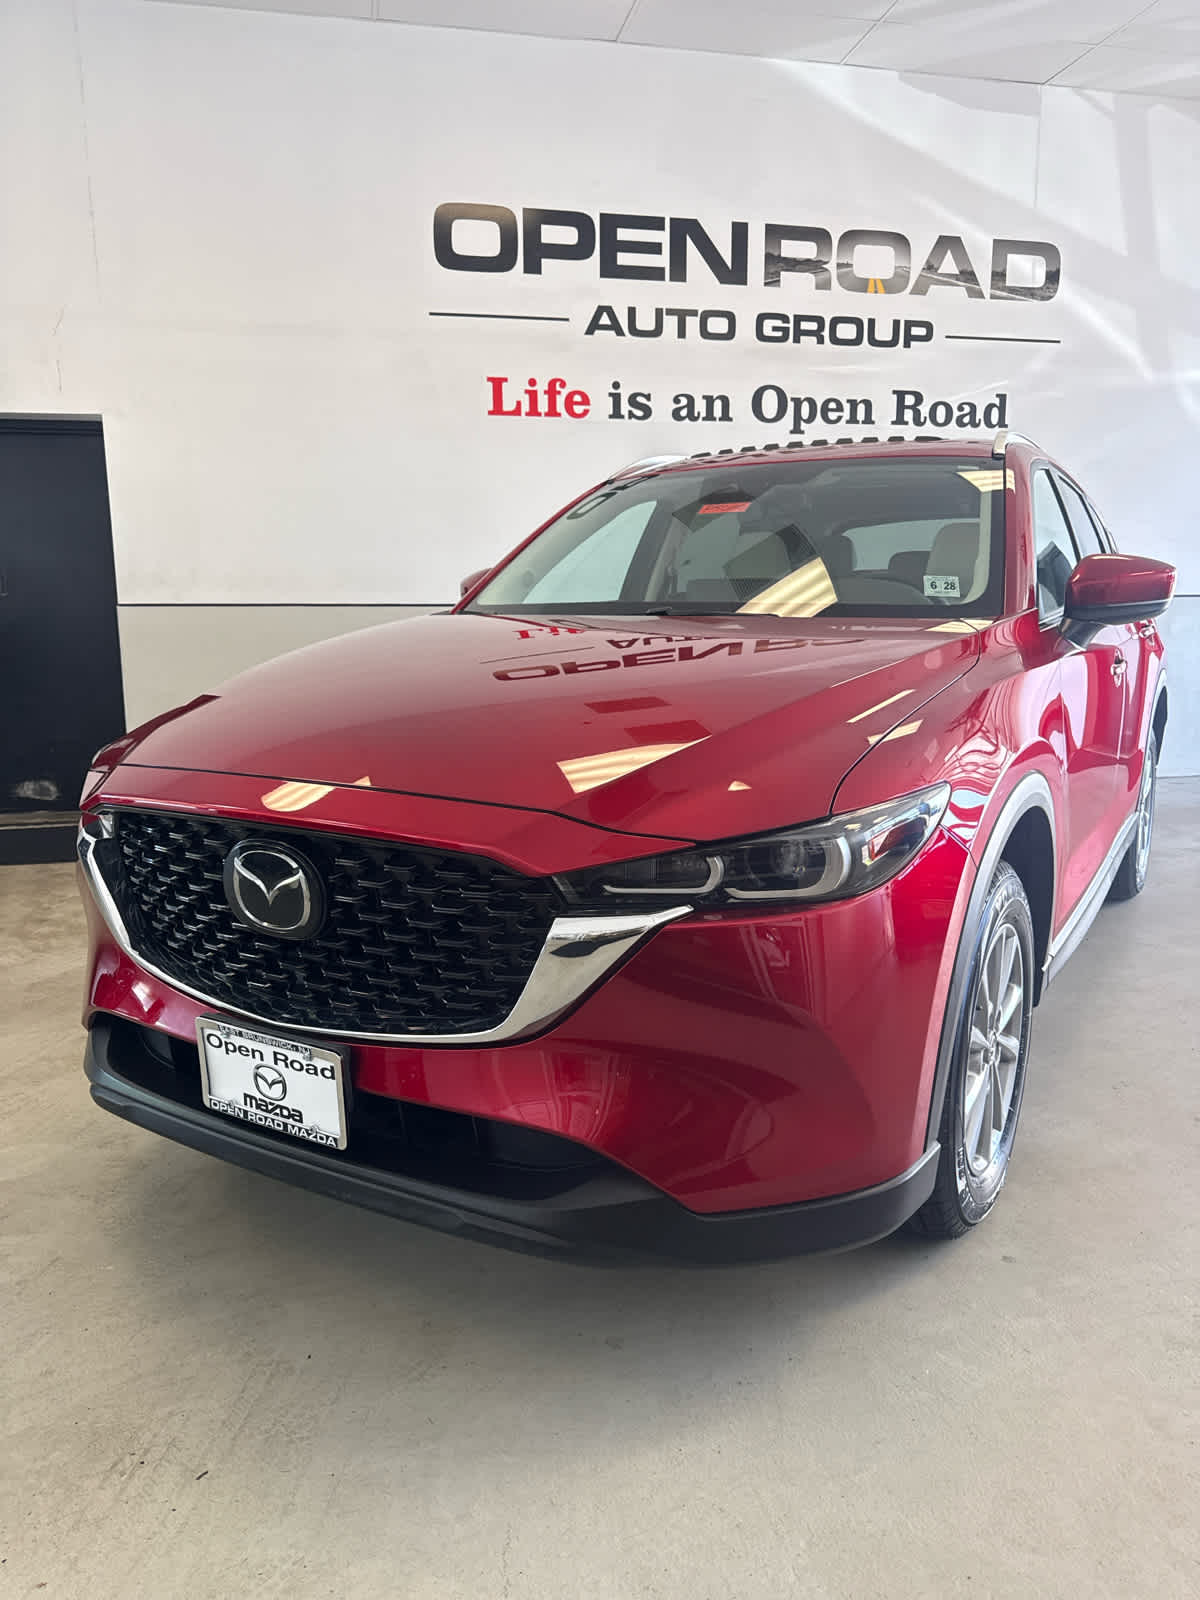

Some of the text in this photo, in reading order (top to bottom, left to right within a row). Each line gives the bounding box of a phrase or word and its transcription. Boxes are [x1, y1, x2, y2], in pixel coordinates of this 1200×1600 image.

[433, 202, 1061, 302] OPEN ROAD
[584, 304, 934, 349] AUTO GROUP
[486, 376, 1009, 435] Life is an Open Road
[930, 581, 956, 590] 6 28
[206, 1033, 336, 1081] Open Road
[210, 1099, 337, 1148] OPEN ROAD MAZDA
[243, 1092, 304, 1124] mazda
